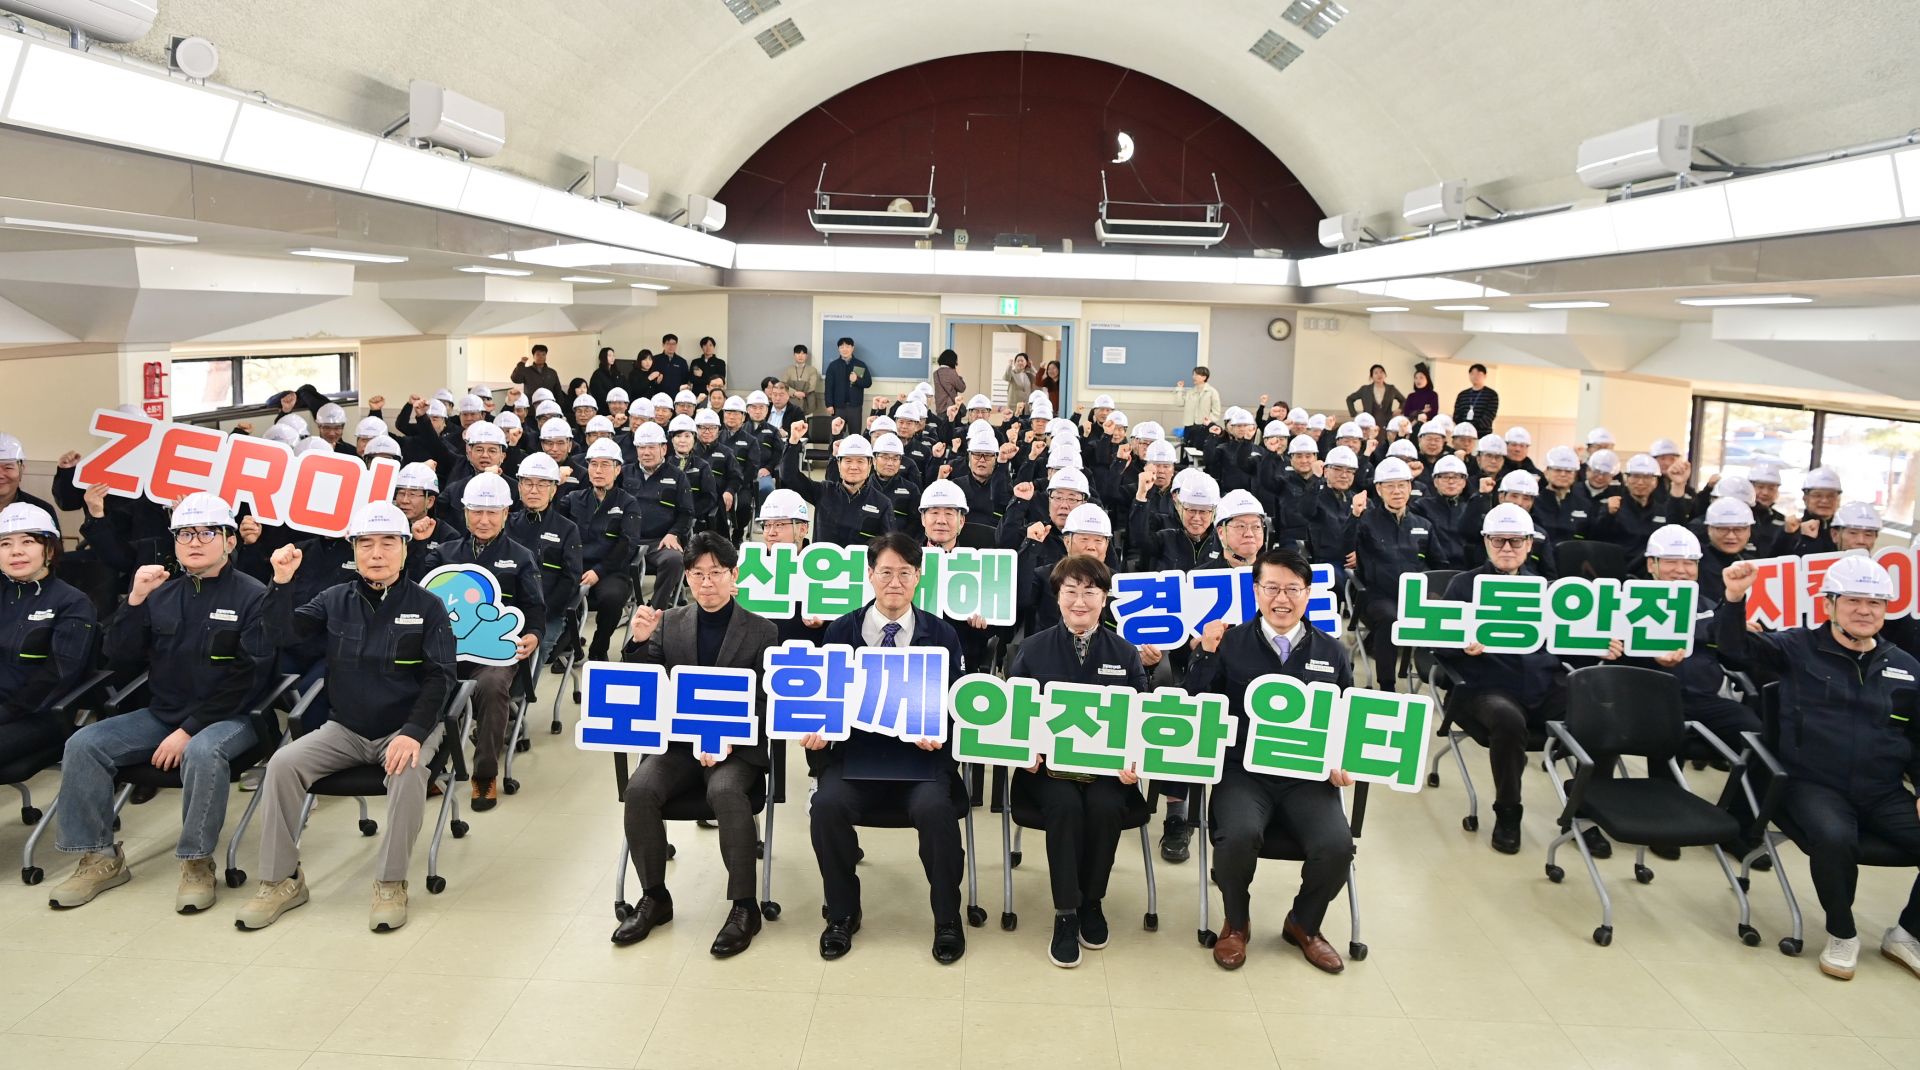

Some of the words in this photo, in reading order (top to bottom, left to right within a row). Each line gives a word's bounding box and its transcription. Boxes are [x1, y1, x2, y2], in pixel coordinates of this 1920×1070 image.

[1397, 579, 1694, 651] 노동안전
[582, 668, 752, 754] 모두
[770, 646, 944, 737] 함께
[955, 681, 1229, 778] 안전한
[1251, 681, 1427, 785] 일터
